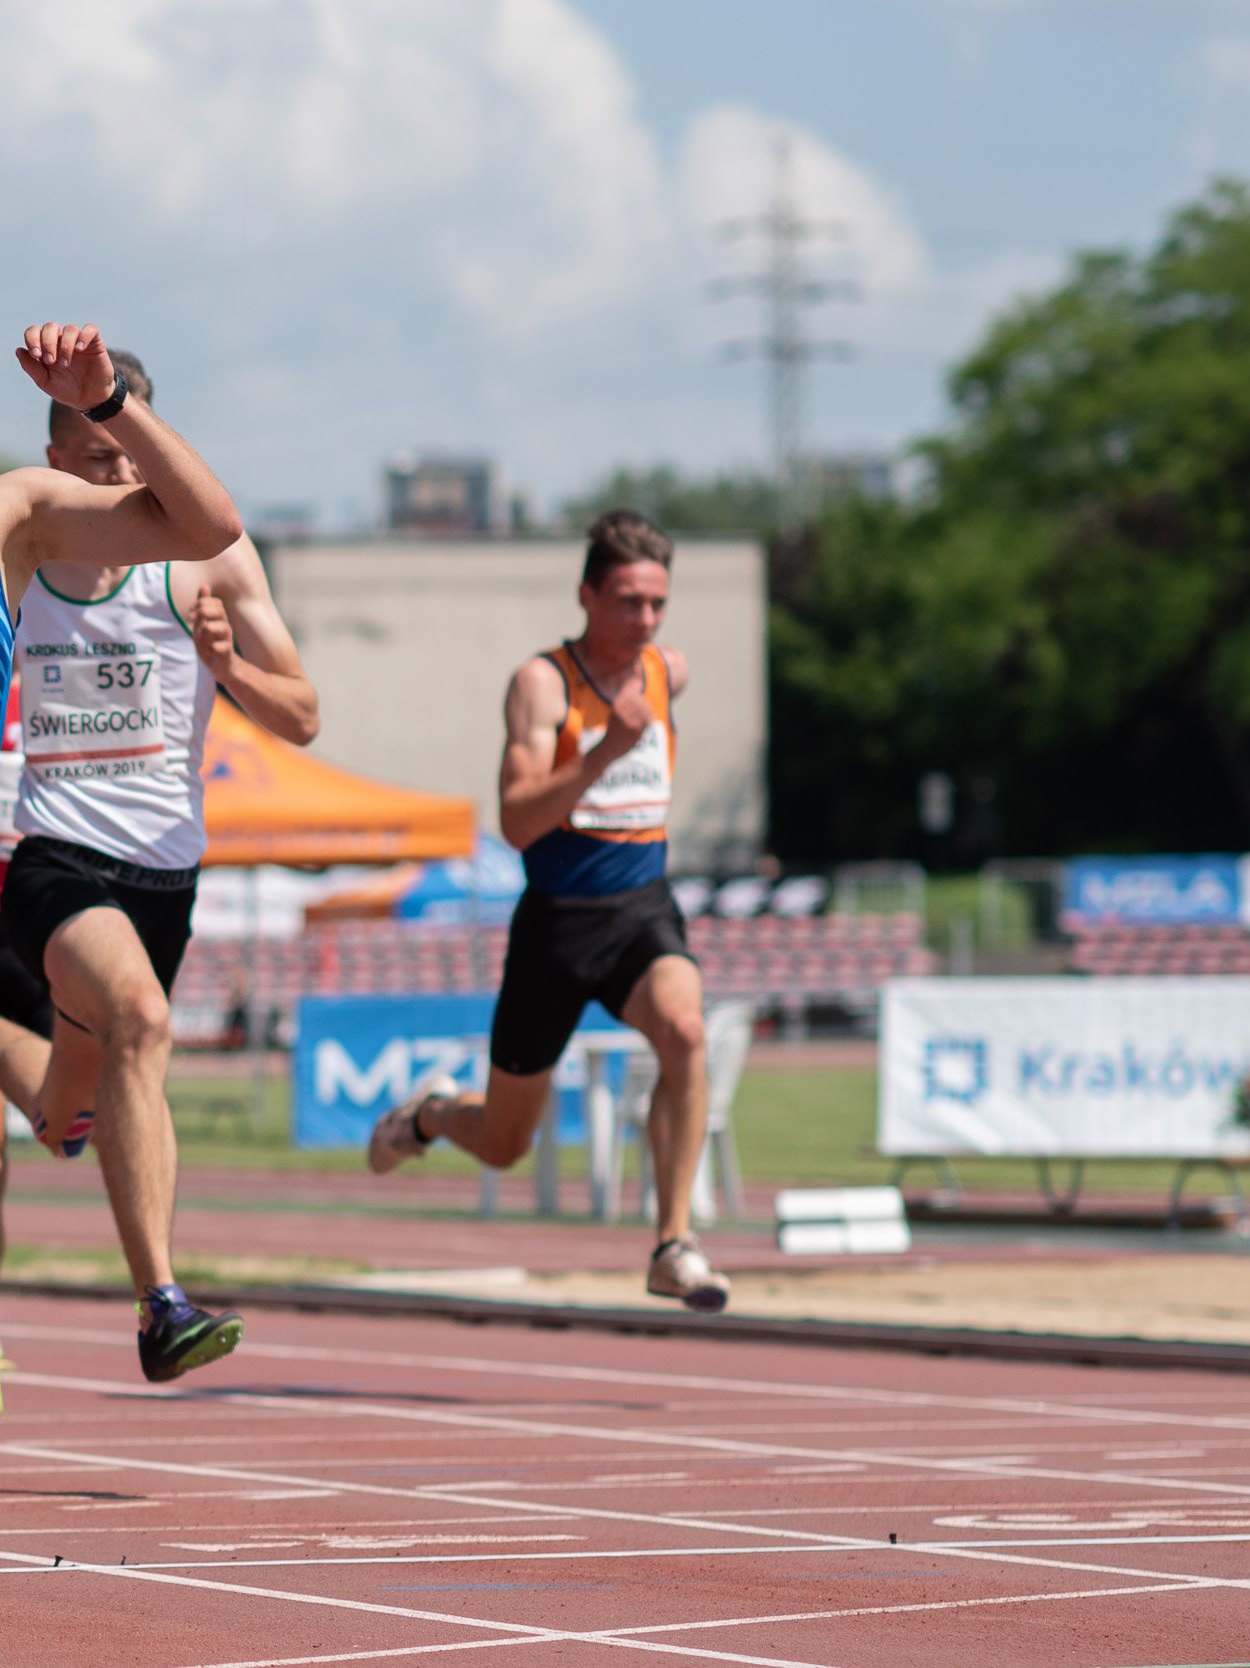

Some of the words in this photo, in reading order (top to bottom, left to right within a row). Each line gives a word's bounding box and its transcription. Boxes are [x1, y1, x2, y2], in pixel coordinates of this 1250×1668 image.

[26, 643, 77, 657] KROKUS
[85, 642, 136, 656] LESZNO
[97, 660, 153, 689] 537
[30, 707, 158, 737] ŚWIERGOCKI
[45, 762, 109, 779] KRAKÓW
[113, 761, 145, 775] 2019
[1018, 1036, 1243, 1098] Kraków
